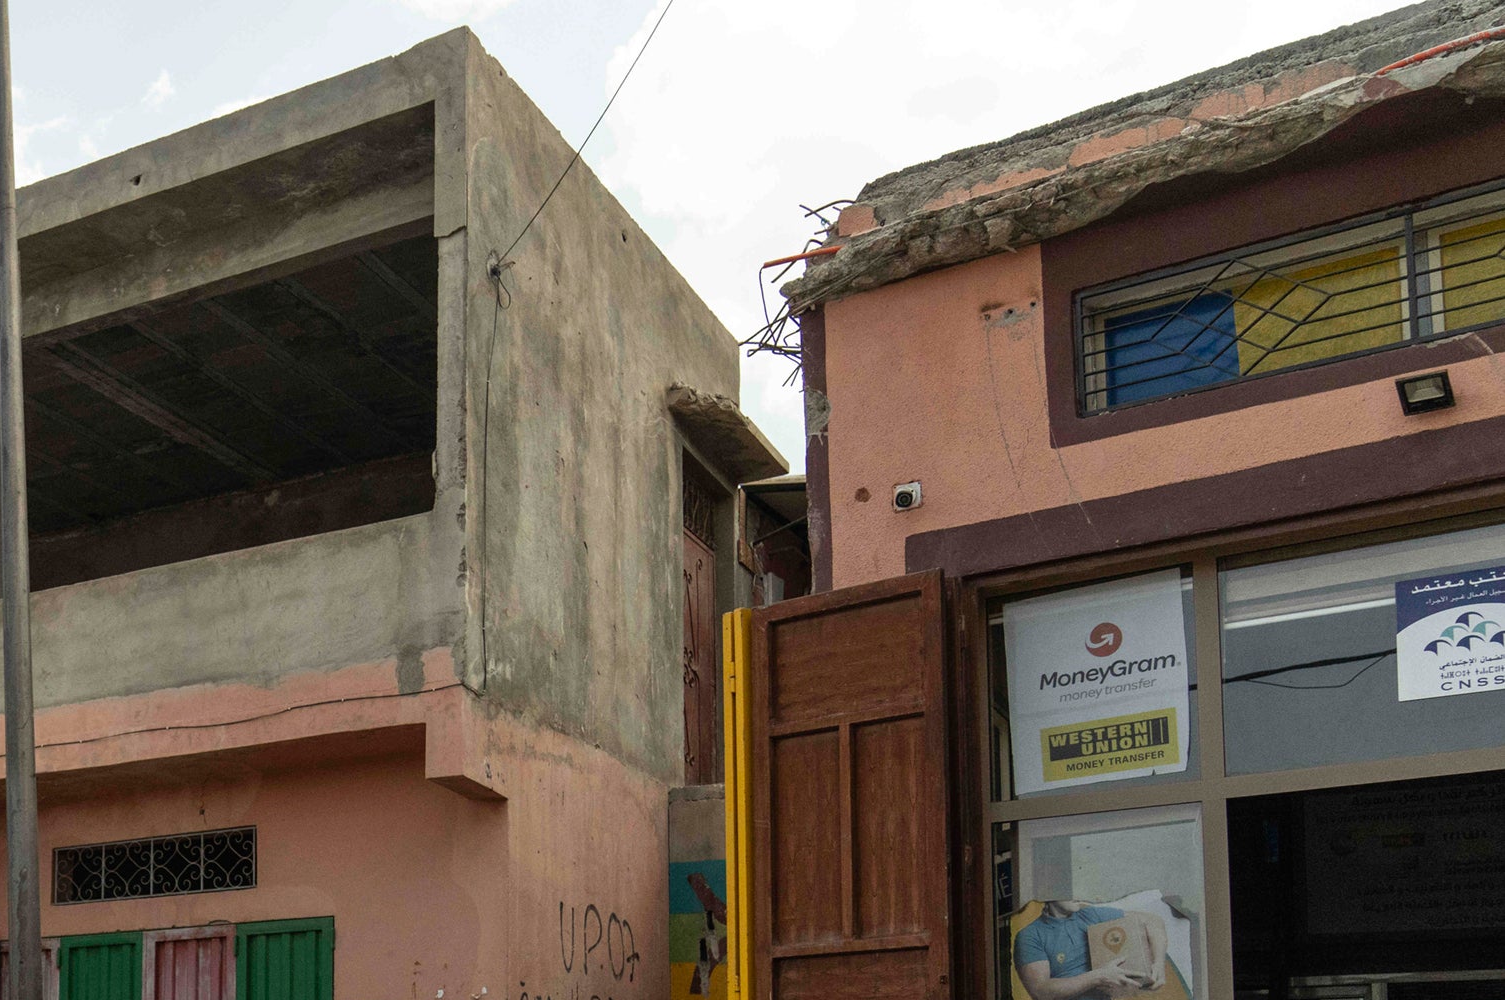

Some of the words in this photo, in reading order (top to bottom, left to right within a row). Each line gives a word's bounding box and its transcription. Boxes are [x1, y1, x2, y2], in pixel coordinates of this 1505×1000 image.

[1410, 579, 1466, 595] معتمد
[1468, 571, 1505, 588] تب
[1467, 590, 1488, 600] العمال
[1039, 654, 1177, 691] MoneyGram
[1440, 674, 1505, 692] CNSS
[1059, 687, 1103, 703] money
[1104, 677, 1158, 695] transfer
[1050, 720, 1149, 748] WESTERN
[1080, 734, 1149, 756] UNION
[1066, 758, 1105, 772] MONEY
[1107, 750, 1165, 767] TRANSFER
